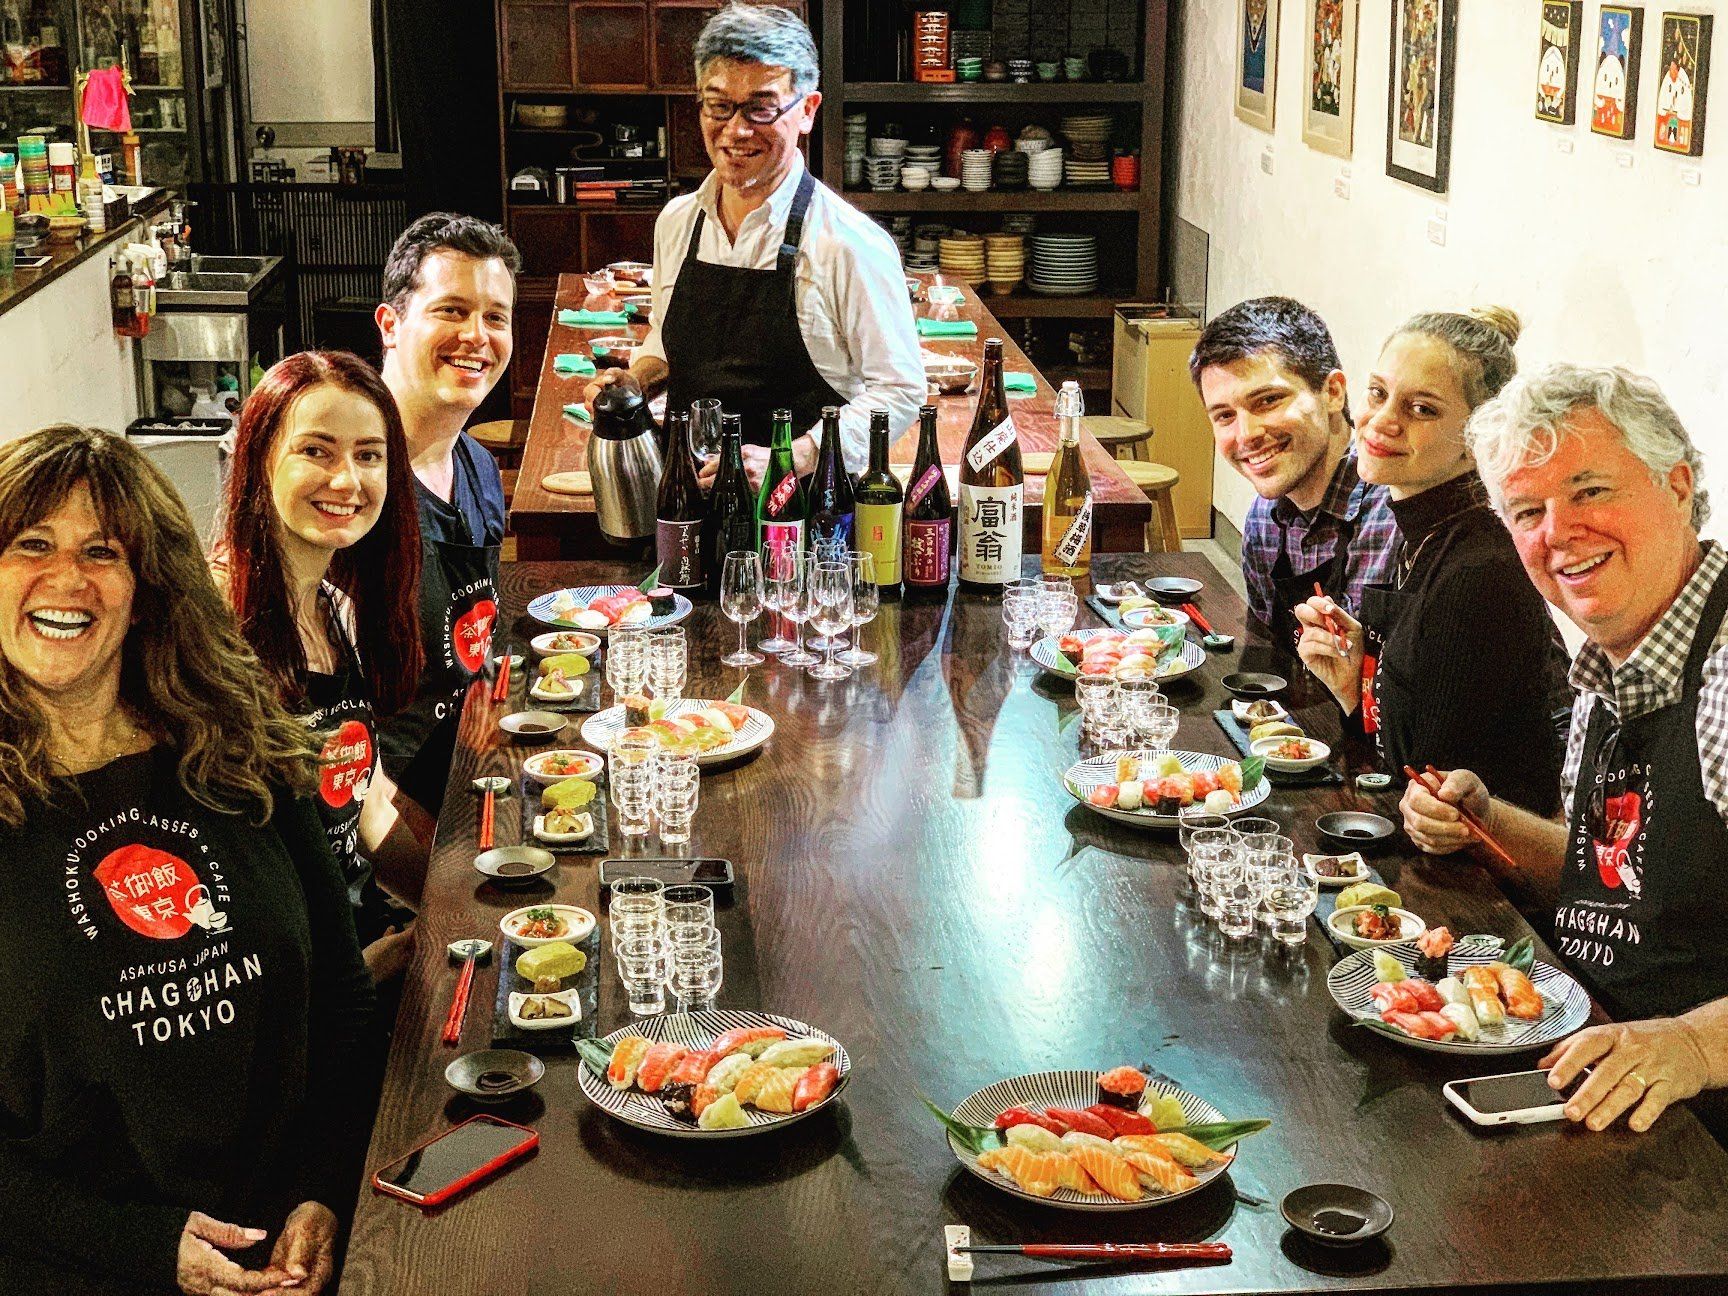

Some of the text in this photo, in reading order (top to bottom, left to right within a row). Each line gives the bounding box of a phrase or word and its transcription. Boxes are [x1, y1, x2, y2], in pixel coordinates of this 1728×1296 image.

[972, 424, 1014, 466] 山廃仕込
[971, 496, 1008, 562] 富翁
[332, 768, 357, 791] 東京
[209, 860, 231, 903] CAFE
[120, 941, 229, 982] ASAKUSA JAPAN
[131, 999, 236, 1046] TOKYO
